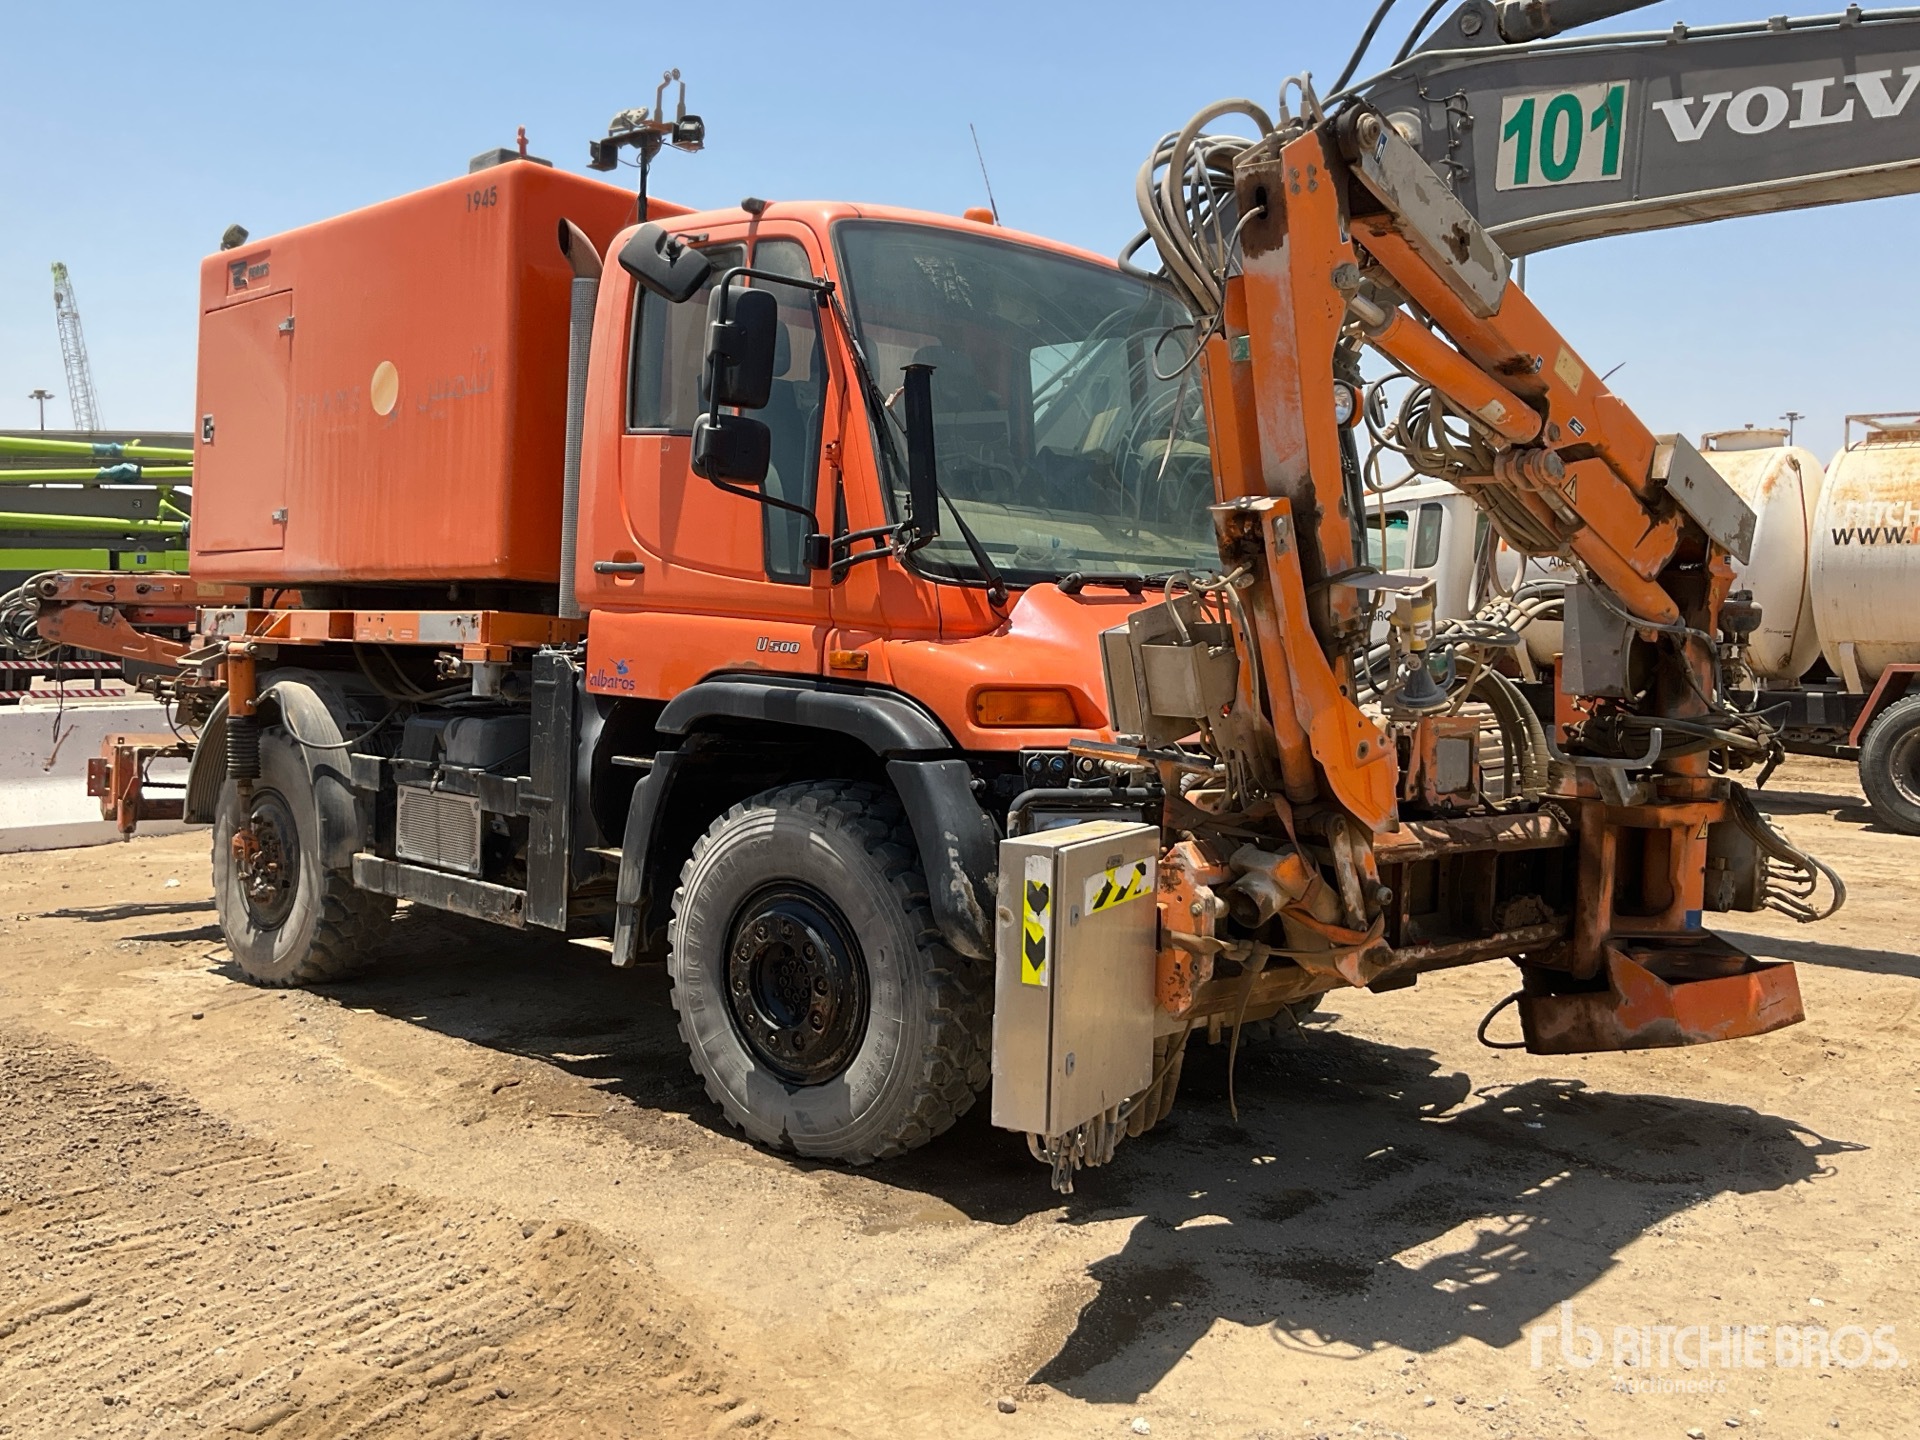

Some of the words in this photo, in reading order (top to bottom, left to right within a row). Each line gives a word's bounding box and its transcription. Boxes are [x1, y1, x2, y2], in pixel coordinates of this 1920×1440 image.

[1503, 84, 1626, 185] 101
[466, 184, 498, 213] 1945
[589, 669, 635, 690] albaros
